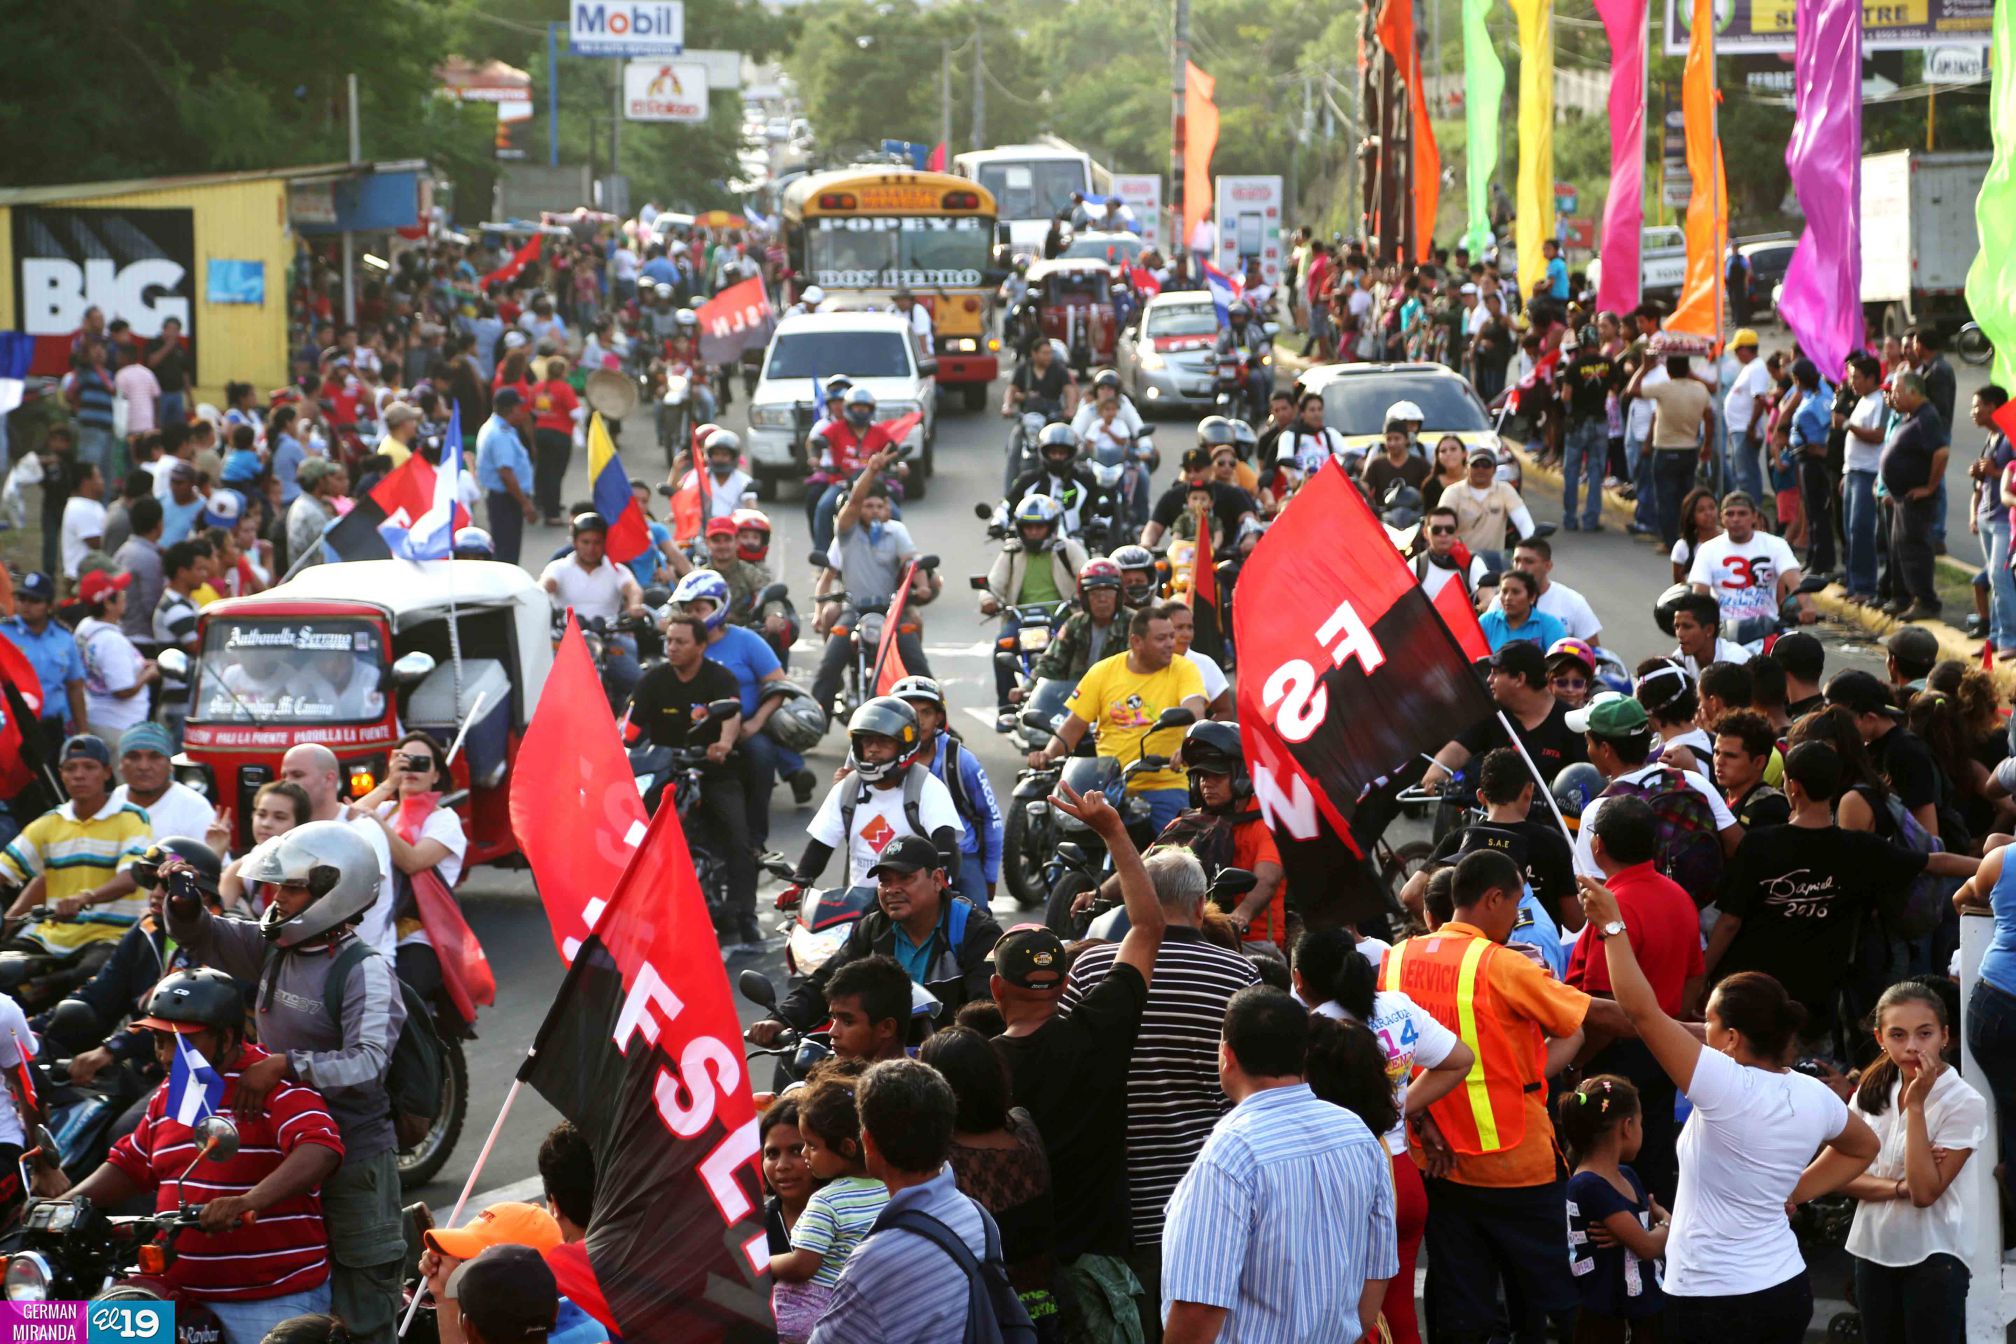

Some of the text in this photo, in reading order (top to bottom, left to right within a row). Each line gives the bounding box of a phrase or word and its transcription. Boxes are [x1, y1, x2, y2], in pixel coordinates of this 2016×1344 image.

[577, 6, 671, 34] Mobil
[1747, 72, 1796, 90] FERRE
[819, 217, 980, 231] POPEYE
[818, 269, 981, 286] DON PEDRO
[22, 258, 190, 339] BIG
[976, 768, 1003, 829] LACOSTE
